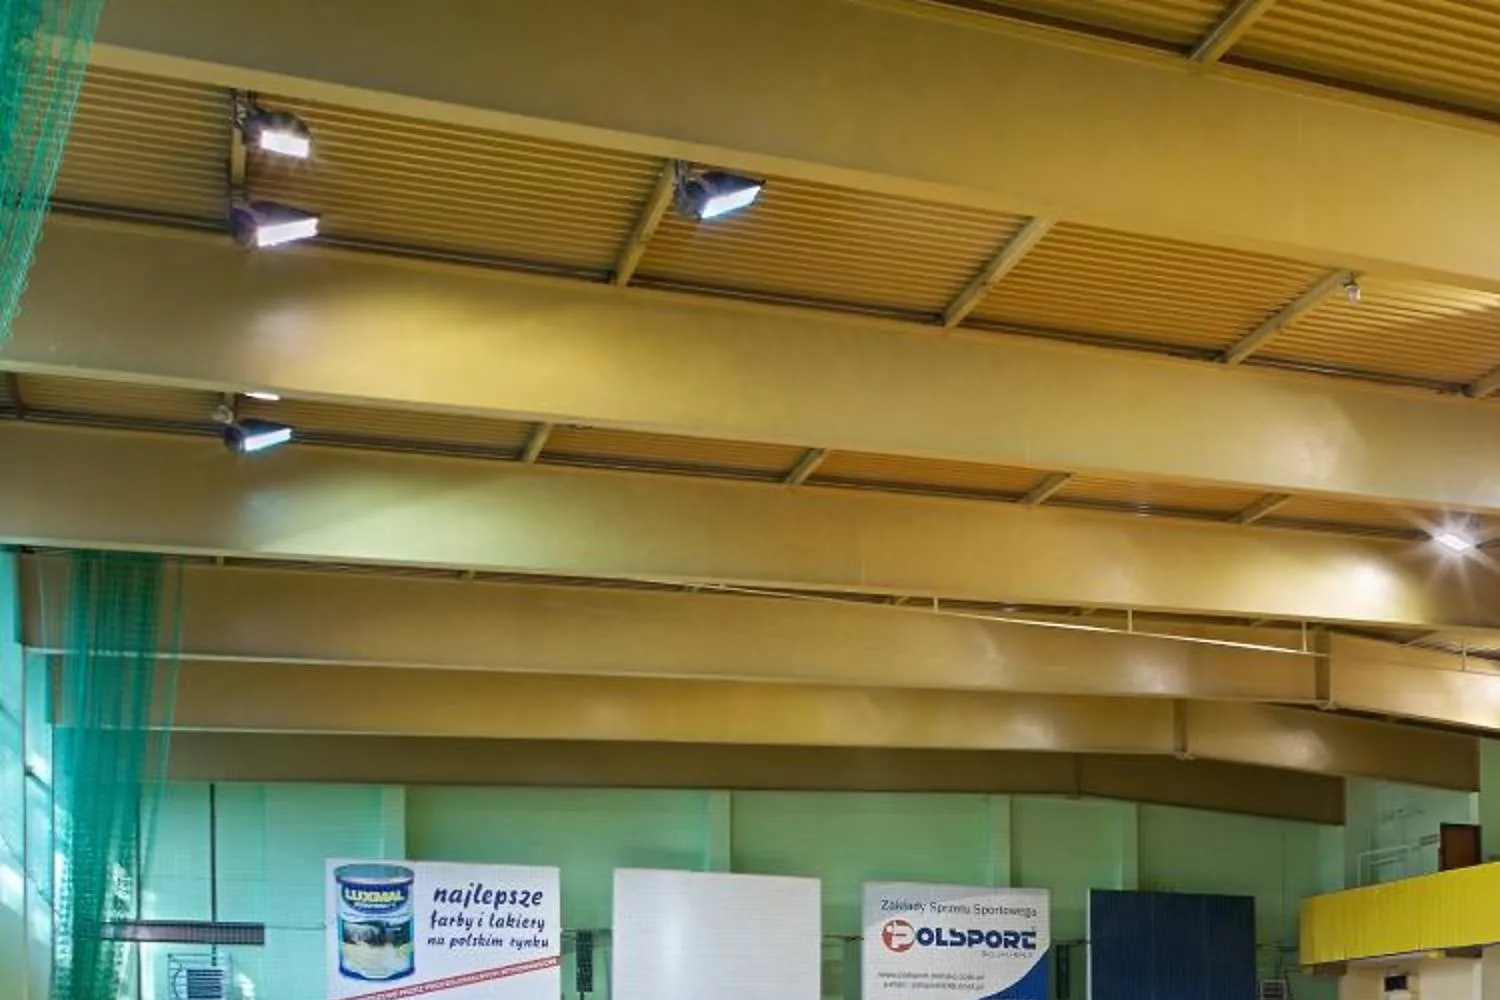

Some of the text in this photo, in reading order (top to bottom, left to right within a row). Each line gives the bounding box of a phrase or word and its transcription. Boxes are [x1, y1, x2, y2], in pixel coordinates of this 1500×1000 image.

[433, 882, 543, 910] najlepsze
[431, 910, 545, 932] farby i lakiery
[427, 932, 549, 951] na polskim rynku
